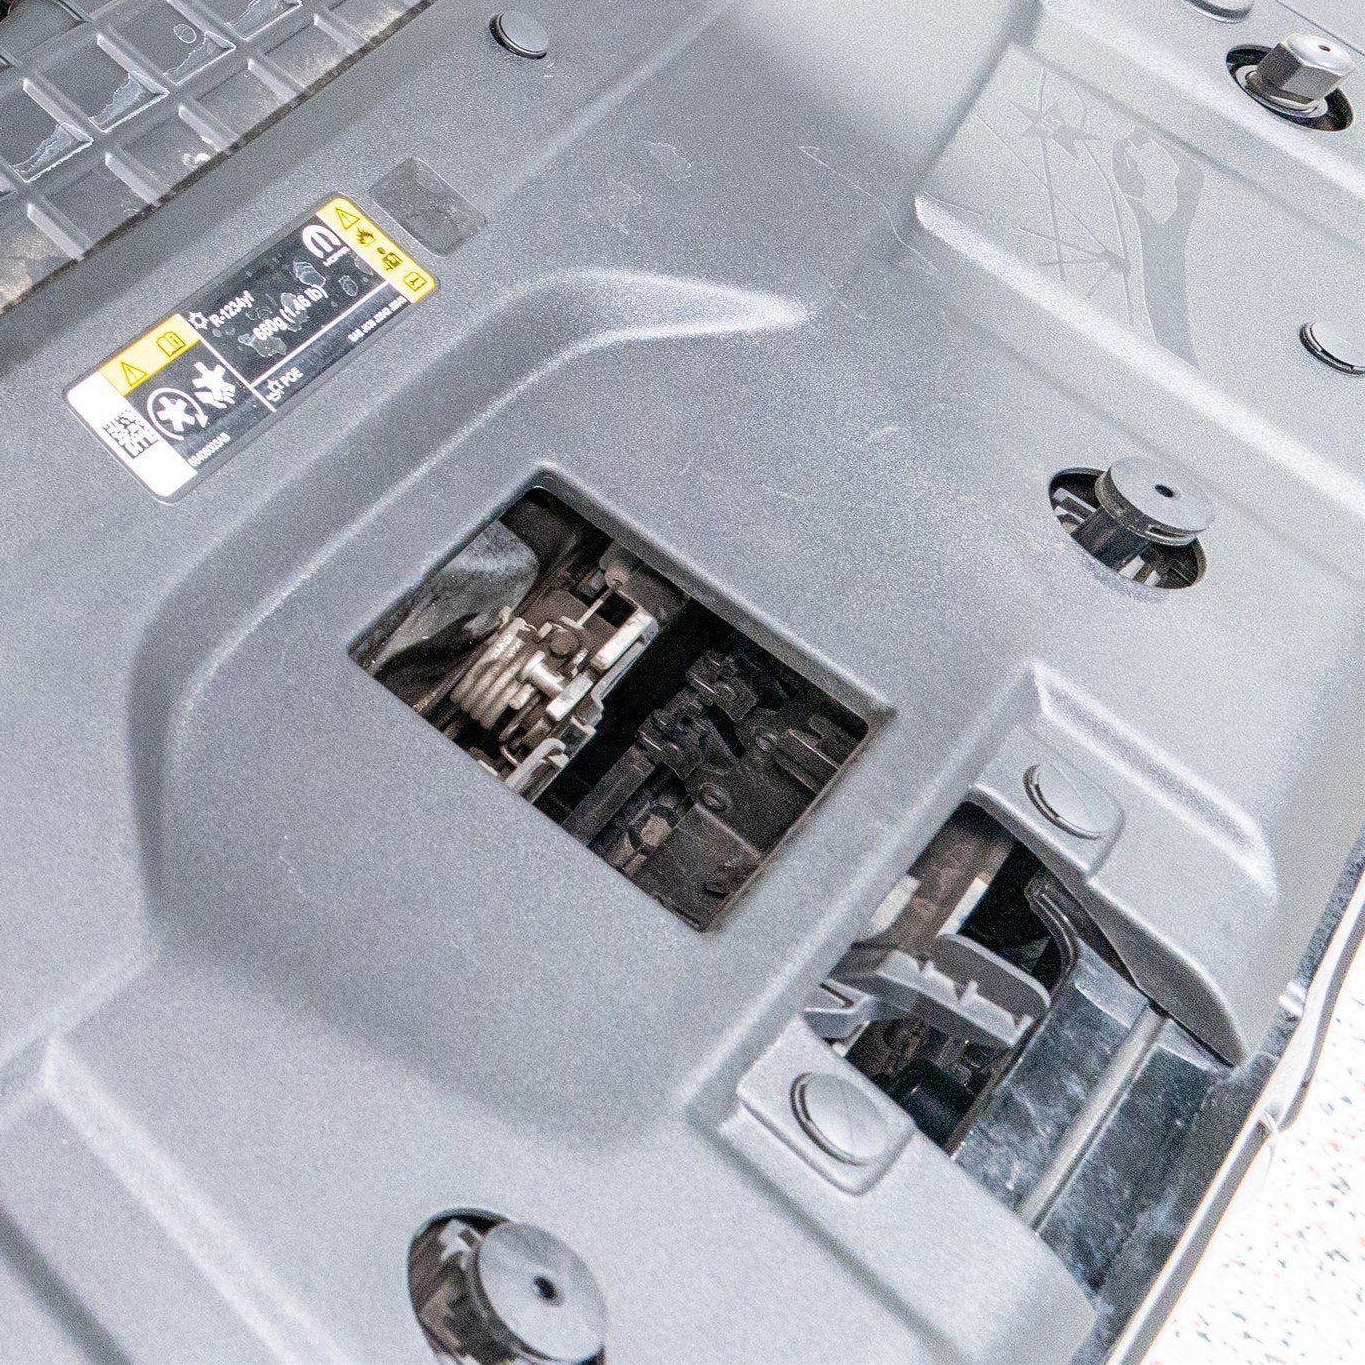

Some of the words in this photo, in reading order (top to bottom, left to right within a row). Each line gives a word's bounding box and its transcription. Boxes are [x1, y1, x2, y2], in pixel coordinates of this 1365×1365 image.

[208, 290, 255, 328] R-1234yf
[253, 315, 287, 341] 660g
[280, 293, 311, 324] (1.46
[306, 283, 329, 303] lb)
[348, 329, 364, 343] SAE
[280, 366, 304, 387] POE
